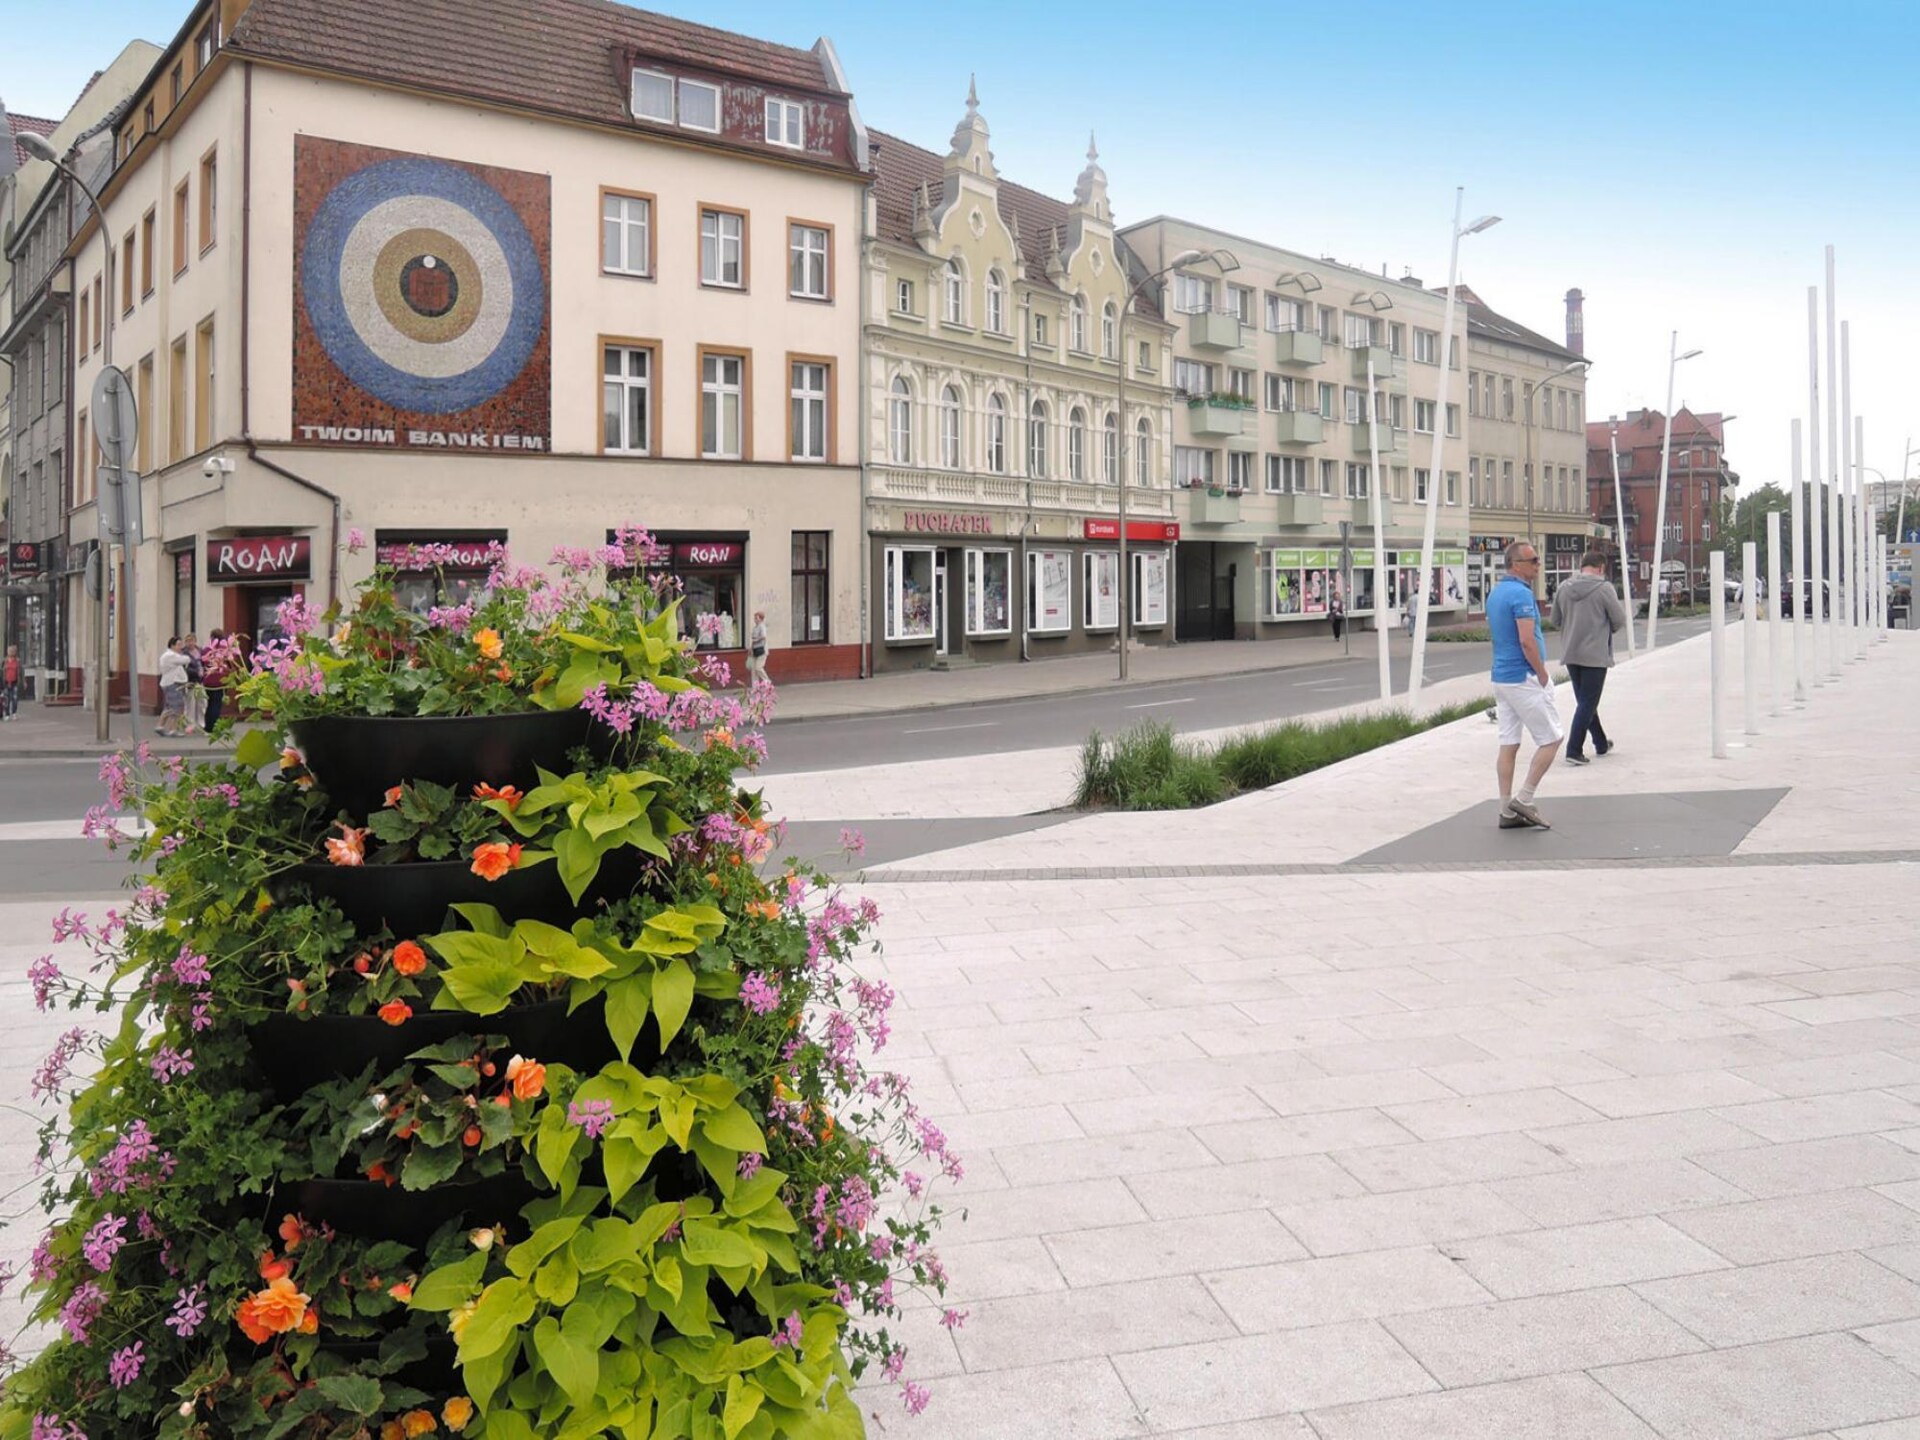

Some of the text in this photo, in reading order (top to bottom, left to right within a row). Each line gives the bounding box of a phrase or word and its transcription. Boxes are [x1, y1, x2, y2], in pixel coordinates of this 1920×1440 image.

[300, 425, 543, 449] TWOIM BANKIEM
[904, 511, 993, 534] PUCHATEK
[218, 542, 298, 573] ROAN
[689, 547, 730, 563] ROAN
